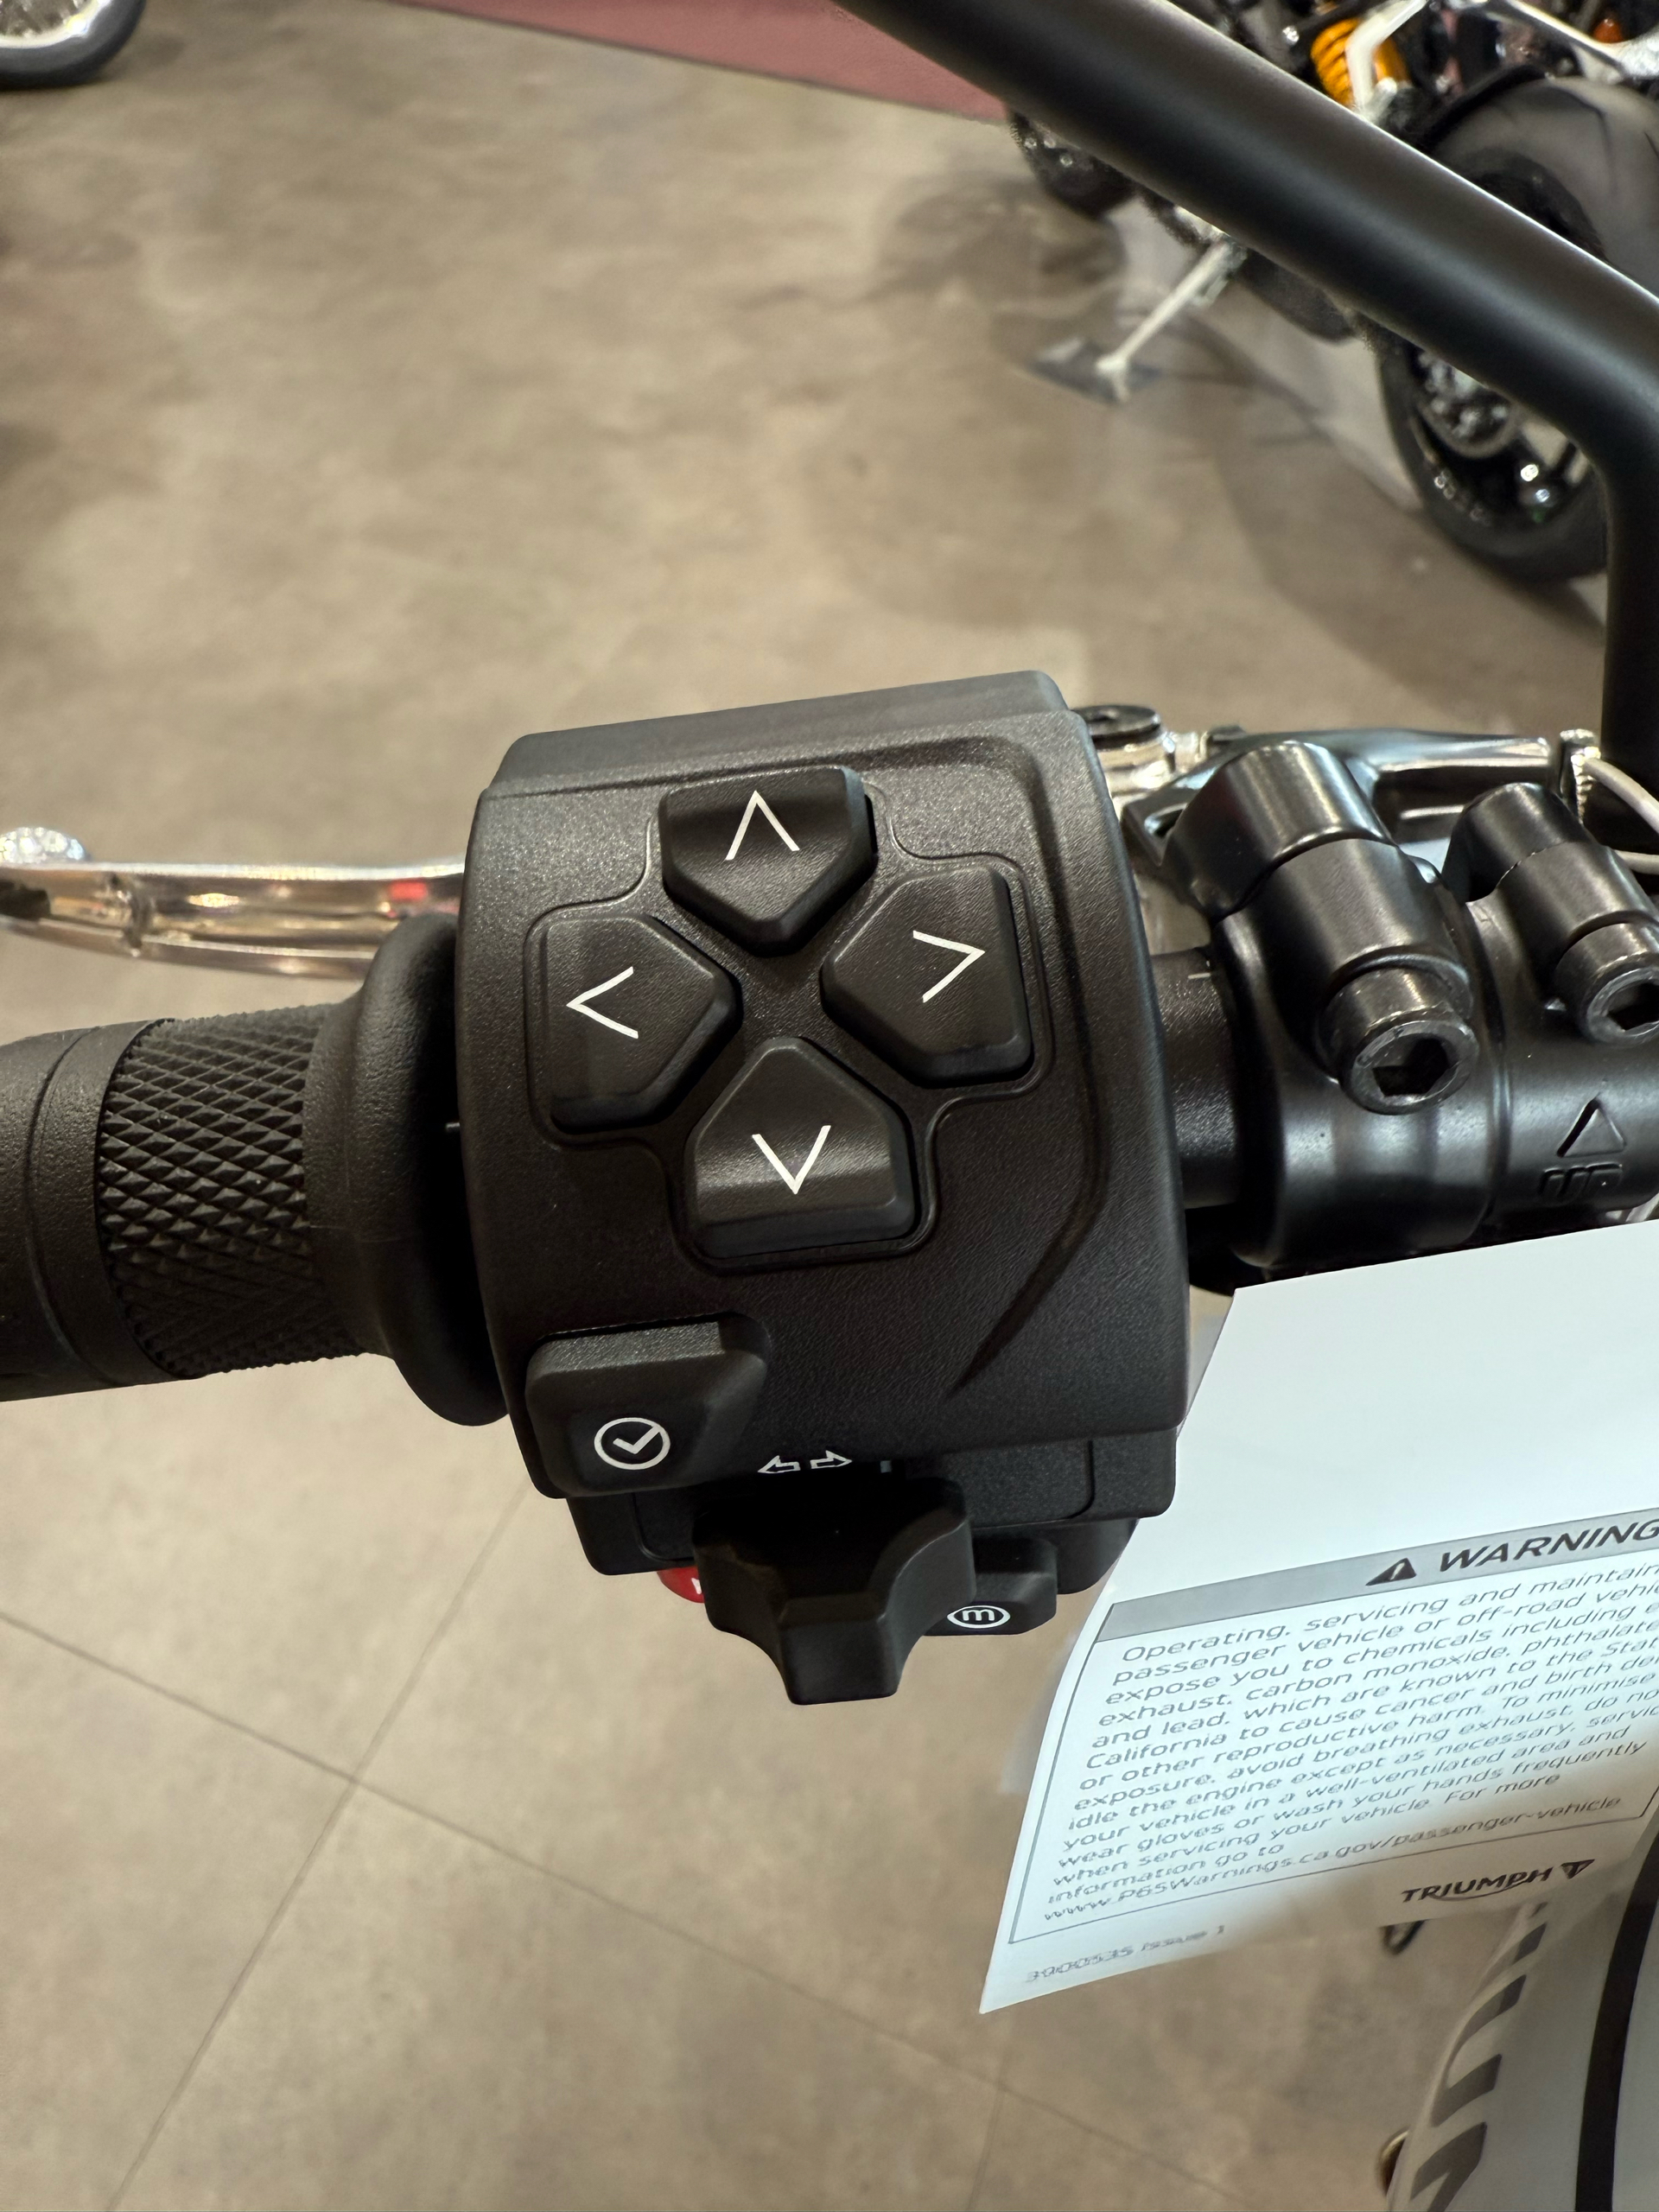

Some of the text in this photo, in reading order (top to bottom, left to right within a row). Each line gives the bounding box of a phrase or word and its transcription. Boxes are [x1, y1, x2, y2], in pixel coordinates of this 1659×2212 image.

[1440, 1518, 1659, 1572] WARNING
[1105, 1676, 1221, 1704] expose
[1230, 1664, 1289, 1687] you
[1302, 1657, 1333, 1671] to
[1344, 1630, 1492, 1664] chemicals
[1502, 1605, 1637, 1637] including
[1112, 1644, 1287, 1686] passenger
[1298, 1625, 1404, 1652] vehicle
[1414, 1618, 1450, 1633] or
[1457, 1592, 1586, 1626] off-road
[1304, 1599, 1449, 1631] servicing
[1459, 1583, 1522, 1606] and
[1079, 1775, 1113, 1790] or
[1122, 1757, 1205, 1781] other
[1213, 1720, 1399, 1763] reproductive
[1503, 1695, 1529, 1709] To
[1536, 1673, 1656, 1703] minimise
[1087, 1734, 1227, 1769] California
[1239, 1726, 1268, 1739] to
[1279, 1709, 1366, 1732] cause
[1375, 1688, 1475, 1715] cancer
[1481, 1675, 1538, 1696] and
[1545, 1662, 1612, 1685] birth
[1092, 1725, 1151, 1748] and
[1243, 1694, 1331, 1719] which
[1340, 1686, 1390, 1703] are
[1399, 1667, 1496, 1693] known
[1507, 1660, 1536, 1674] to
[1546, 1649, 1593, 1667] the
[1246, 1674, 1352, 1700] carbon
[1069, 1812, 1118, 1830] idle
[1129, 1800, 1177, 1817] the
[1185, 1778, 1282, 1805] engine
[1291, 1758, 1386, 1783] except
[1394, 1750, 1424, 1764] as
[1434, 1722, 1575, 1756] necessary,
[1227, 1753, 1305, 1779] avoid
[1313, 1728, 1450, 1762] breathing
[1585, 1696, 1618, 1711] do
[1053, 1861, 1128, 1885] when
[1139, 1833, 1260, 1866] servicing
[1269, 1818, 1332, 1840] your
[1444, 1788, 1487, 1804] For
[1494, 1774, 1560, 1795] more
[1058, 1741, 1647, 1868] wear gloves or wash your hands frequently
[1063, 1725, 1630, 1852] your vehicle in a well-ventilated area and
[1048, 1845, 1284, 1904] information go to
[1401, 1866, 1554, 1903] TRIUMPH
